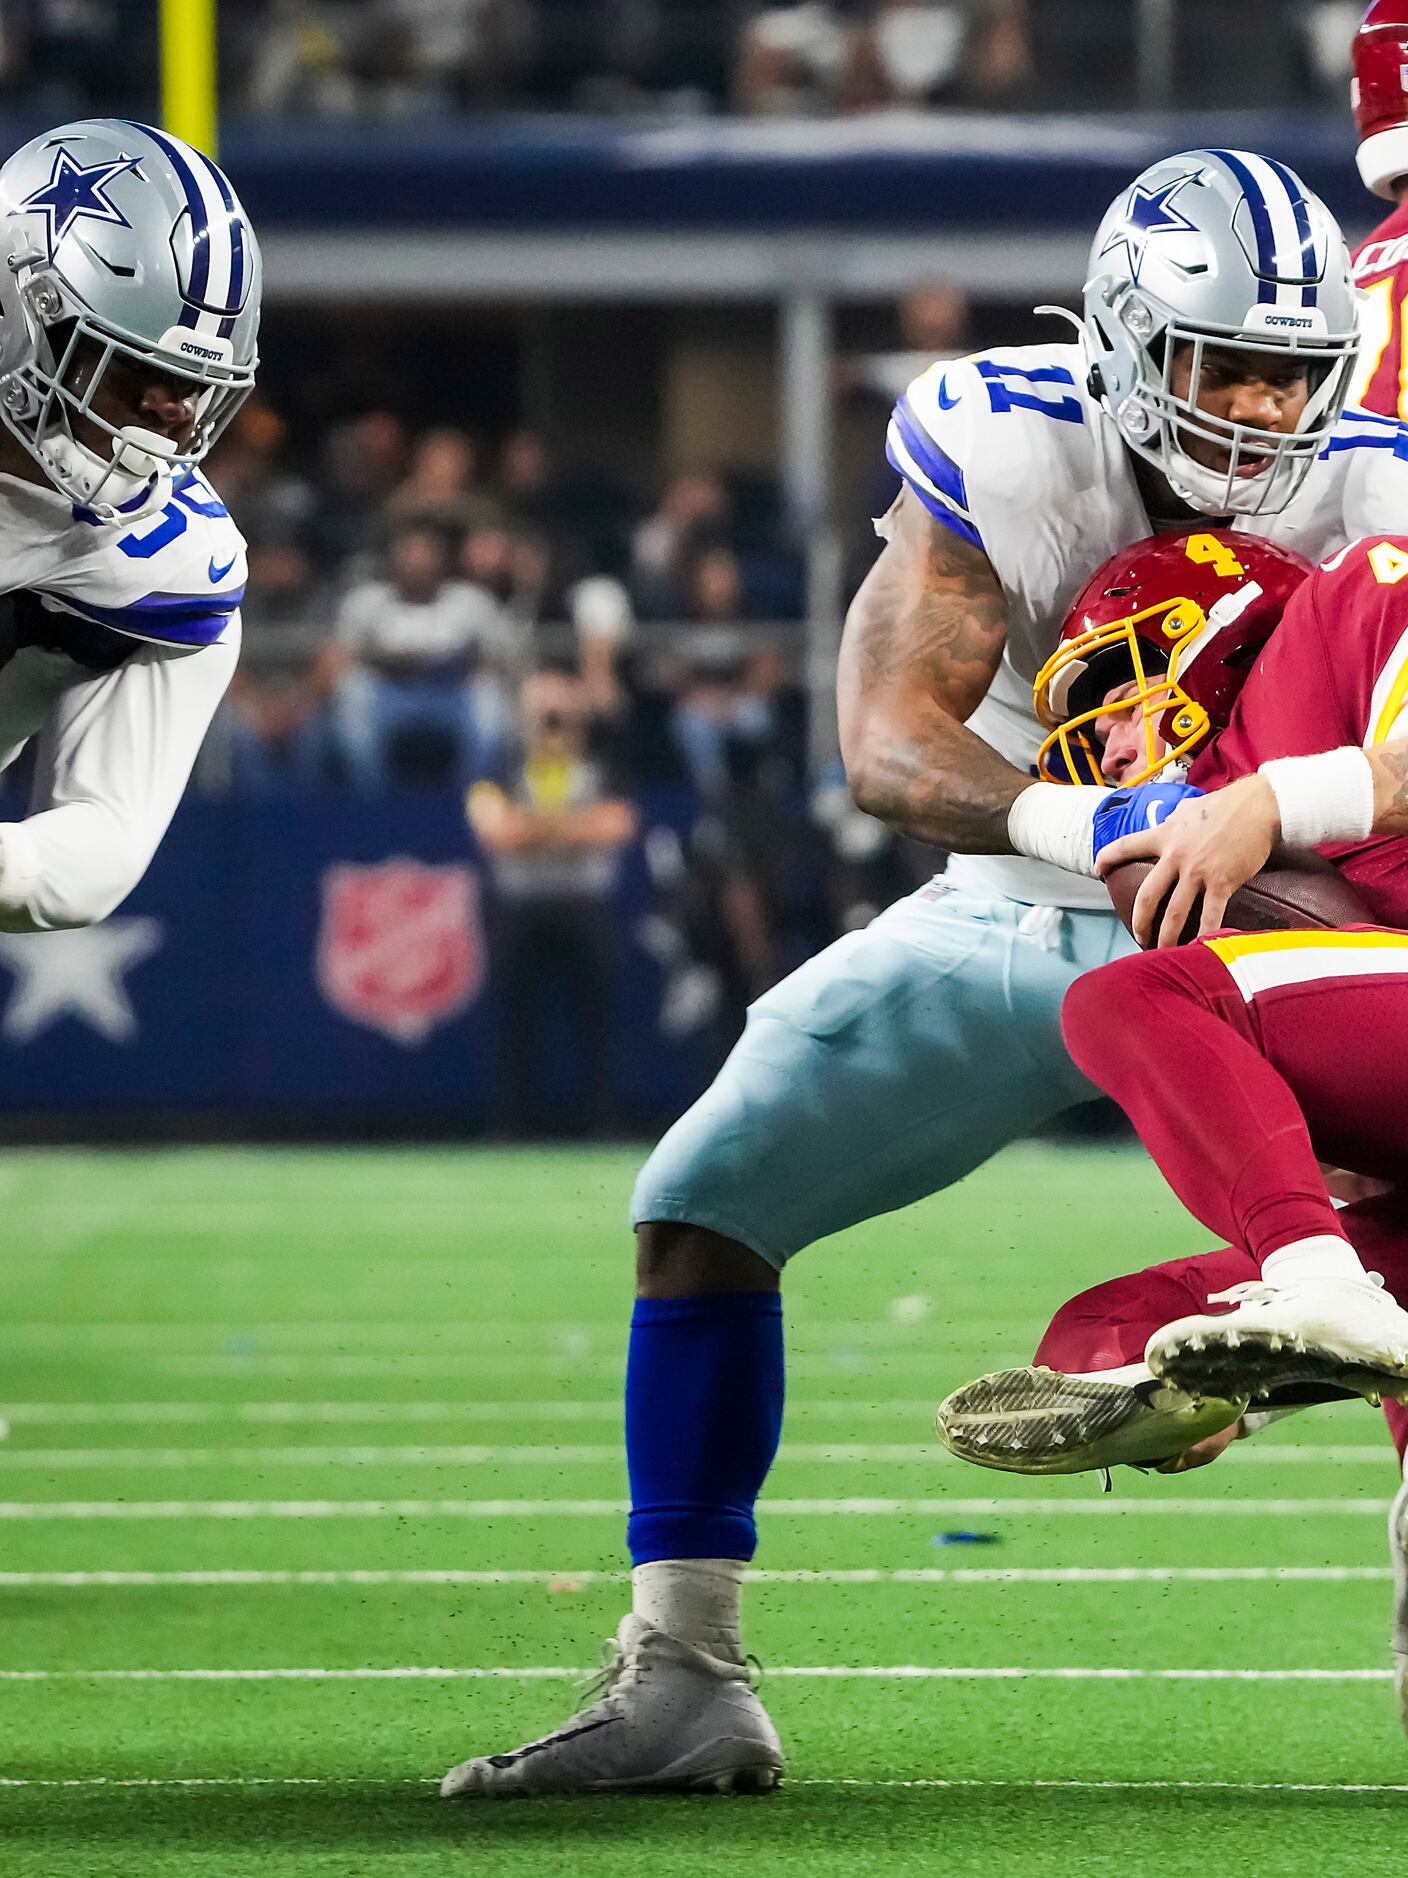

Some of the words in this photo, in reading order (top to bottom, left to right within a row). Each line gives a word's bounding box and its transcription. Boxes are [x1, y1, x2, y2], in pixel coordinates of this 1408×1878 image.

[1265, 315, 1313, 328] COWBOYS
[180, 341, 224, 361] COWBOYS
[974, 359, 1085, 425] 11
[1185, 533, 1245, 577] 4
